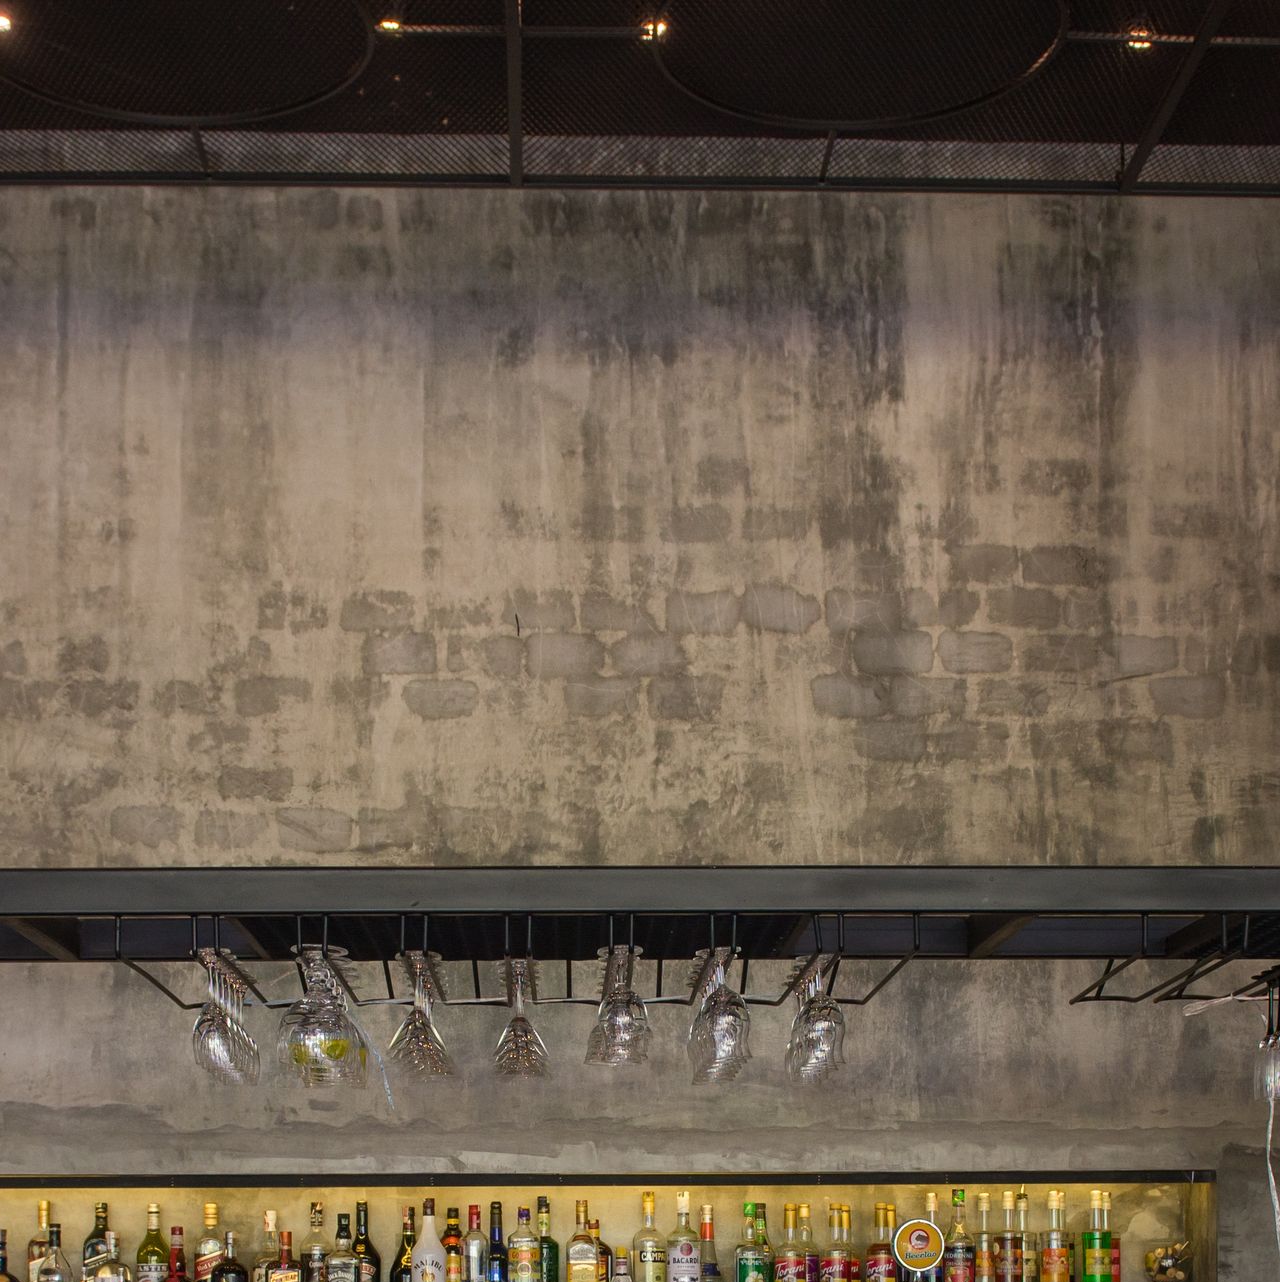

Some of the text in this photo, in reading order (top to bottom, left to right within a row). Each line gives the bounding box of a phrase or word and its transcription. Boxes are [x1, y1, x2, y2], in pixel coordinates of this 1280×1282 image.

[641, 1252, 665, 1261] CAMPA
[905, 1251, 937, 1260] Beerlao
[137, 1264, 167, 1272] ASTIS
[414, 1259, 443, 1271] MALIBU
[775, 1261, 805, 1281] Torani
